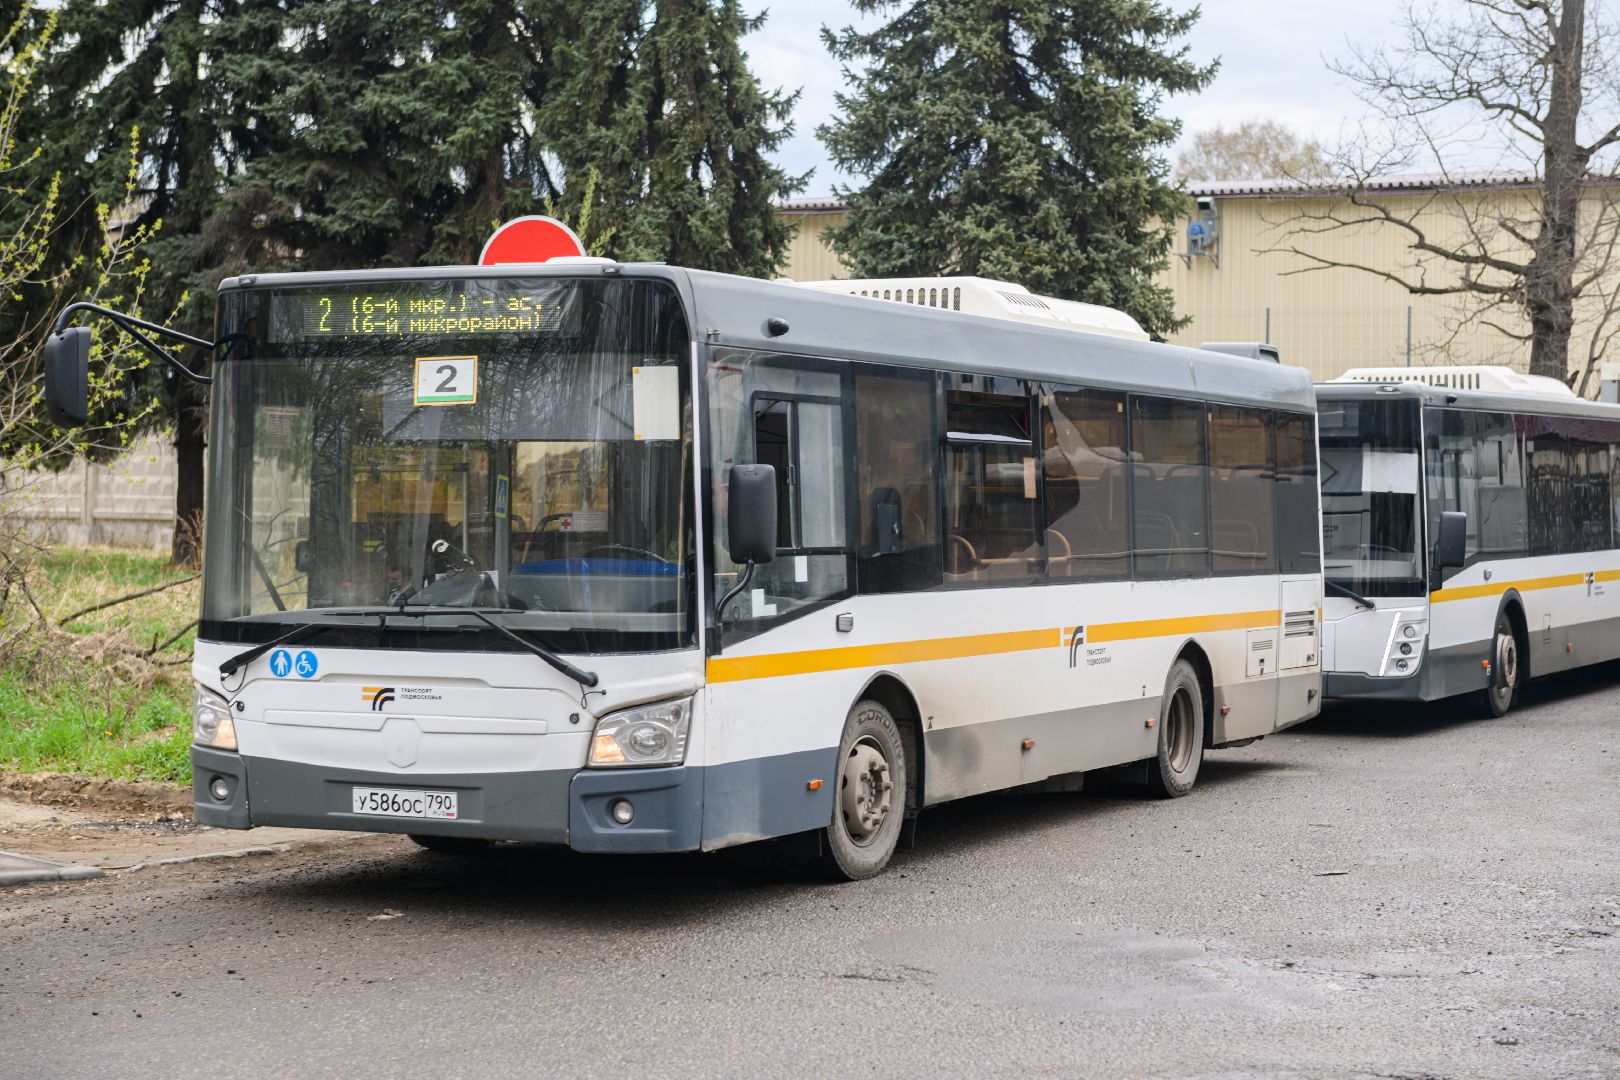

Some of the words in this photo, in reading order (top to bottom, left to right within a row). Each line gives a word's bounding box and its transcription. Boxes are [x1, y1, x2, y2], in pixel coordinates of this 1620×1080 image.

[319, 298, 332, 332] 2
[352, 296, 399, 315] (6-й
[409, 294, 466, 315] мкр.)
[352, 315, 399, 333] (6-й
[409, 312, 540, 334] микрорайон)
[434, 364, 458, 393] 2
[359, 792, 423, 814] У586ОС
[426, 794, 453, 810] 790
